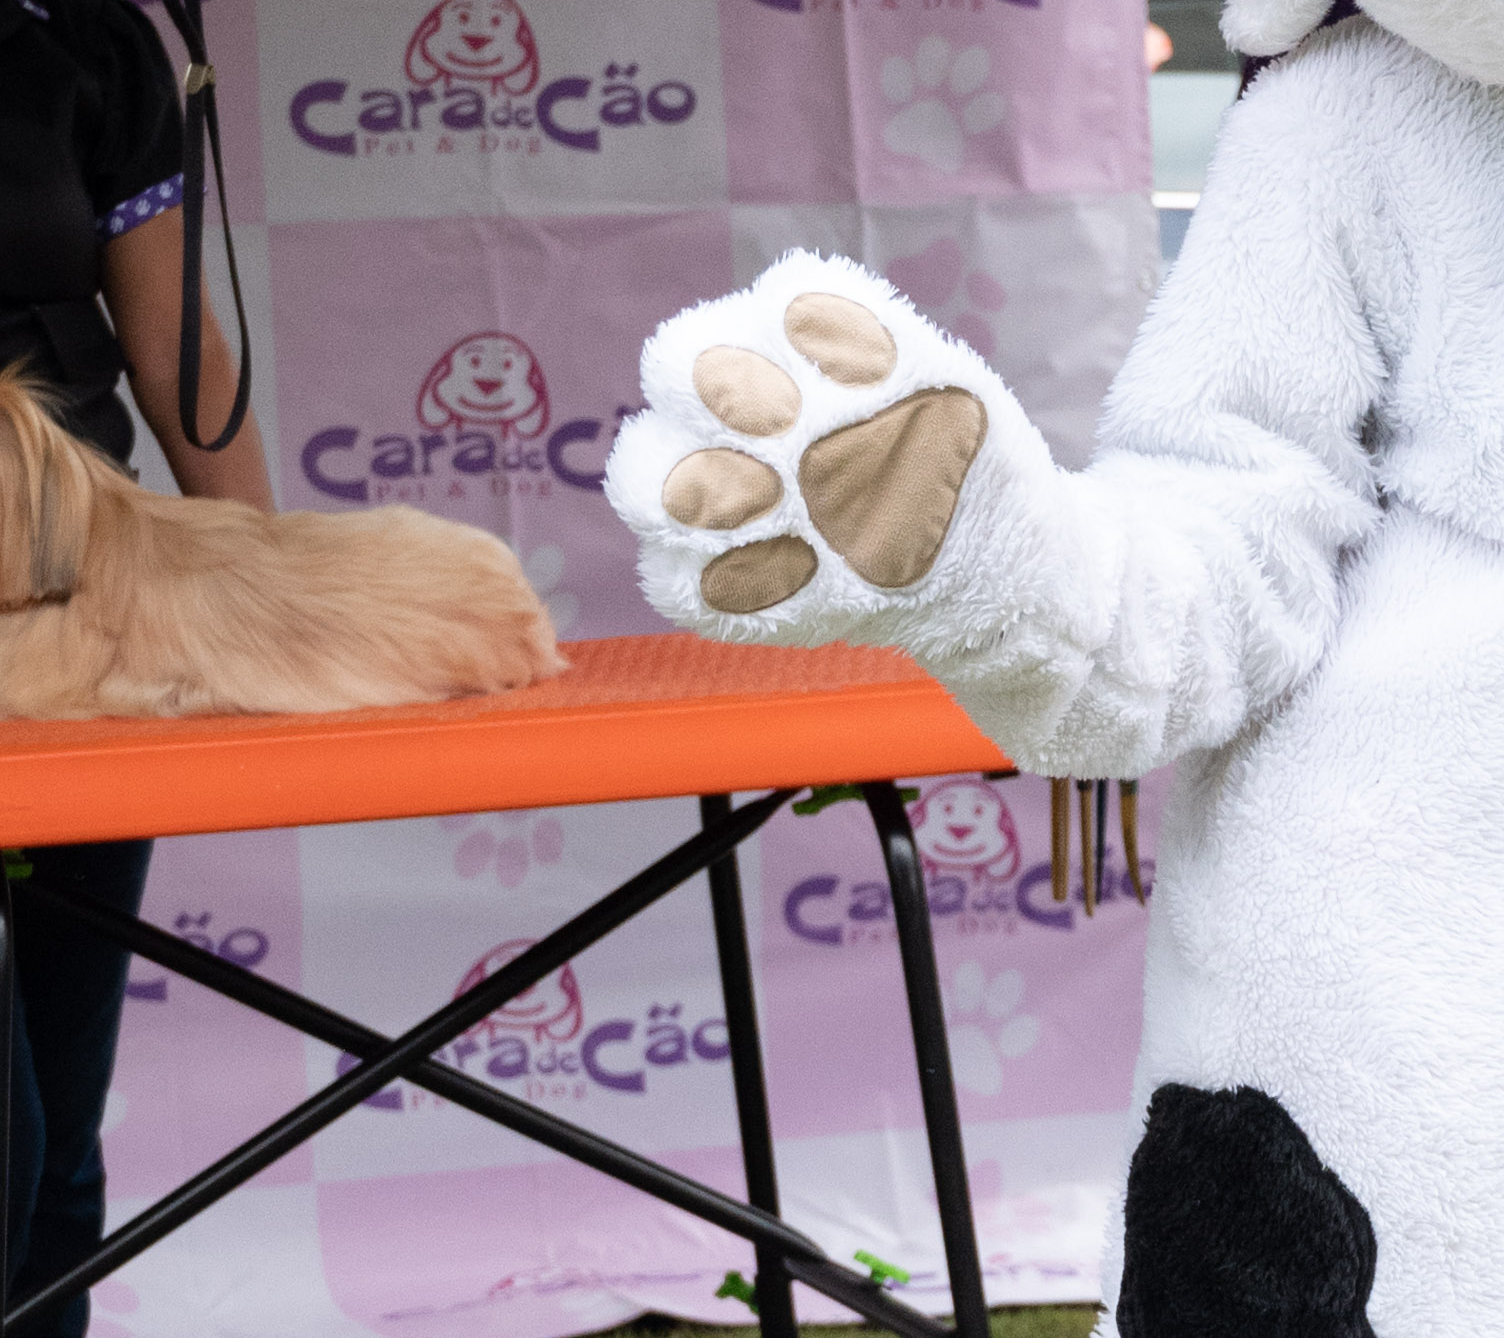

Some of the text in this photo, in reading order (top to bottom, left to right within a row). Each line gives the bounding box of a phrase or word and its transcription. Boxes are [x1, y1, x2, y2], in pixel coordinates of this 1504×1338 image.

[289, 79, 486, 156] Cara
[489, 98, 534, 129] de
[362, 136, 415, 156] Pet
[477, 134, 543, 156] Dog
[302, 426, 495, 504] Cara
[498, 440, 543, 472] de
[783, 874, 968, 945] Caa
[534, 1044, 582, 1076] de
